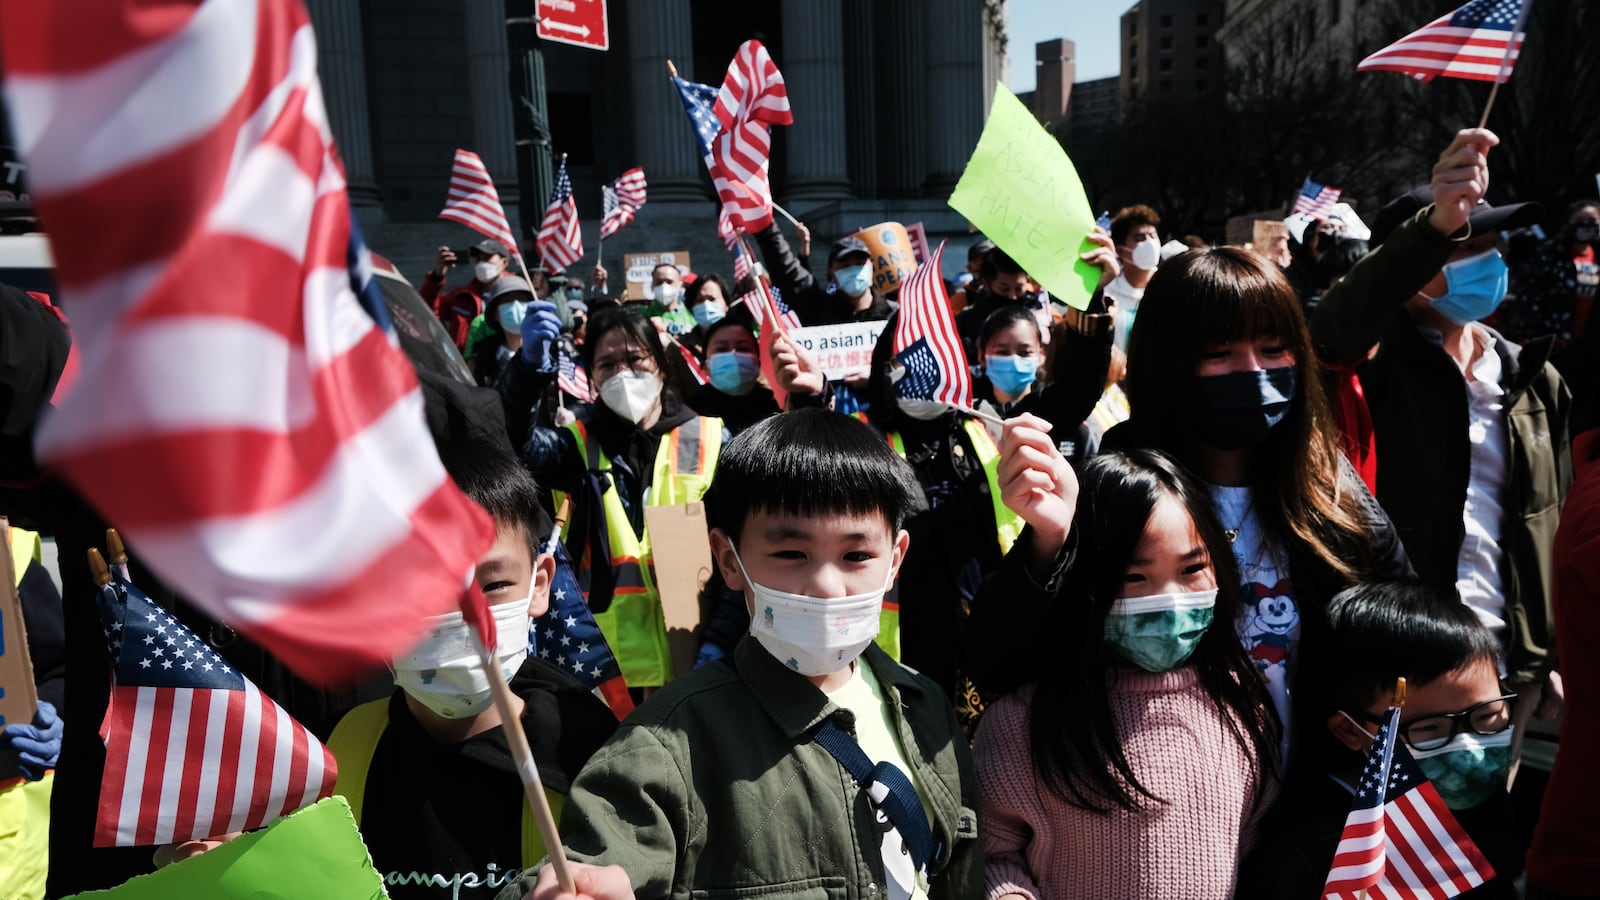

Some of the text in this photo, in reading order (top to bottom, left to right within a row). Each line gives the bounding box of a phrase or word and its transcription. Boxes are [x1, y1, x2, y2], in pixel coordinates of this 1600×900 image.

[995, 141, 1072, 217] ASIAN
[631, 255, 657, 266] THIS
[819, 334, 864, 350] asian
